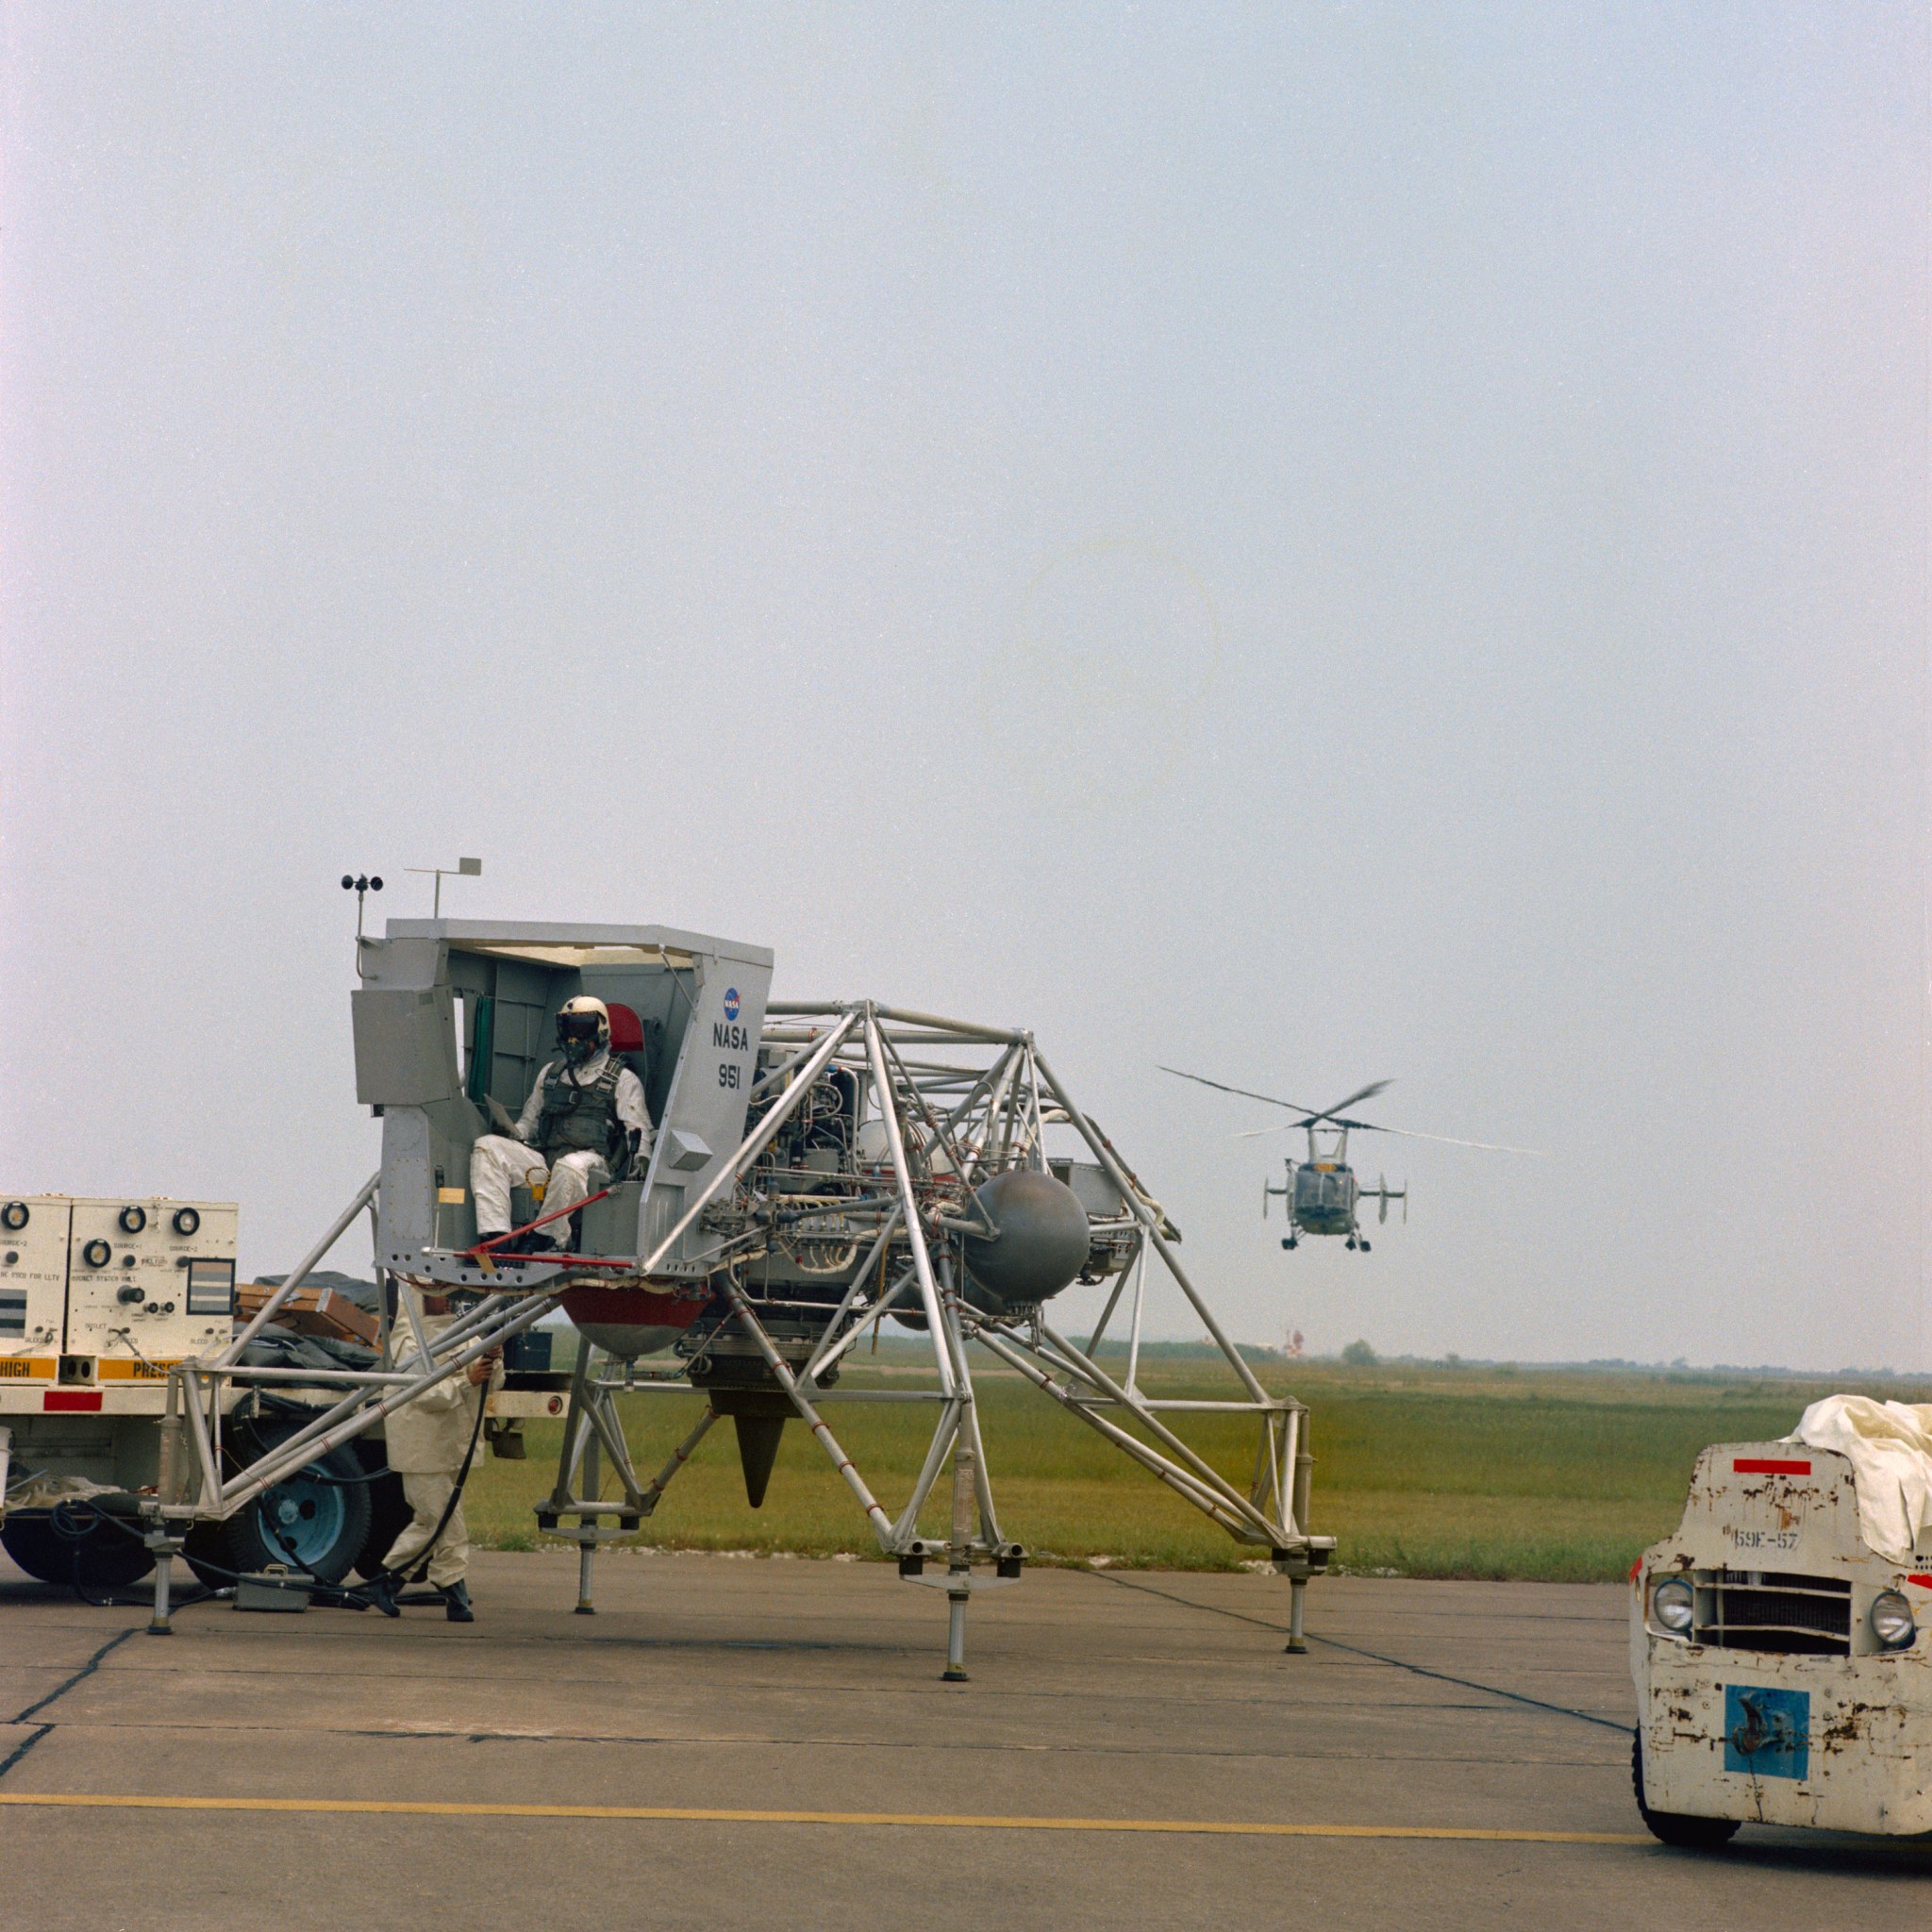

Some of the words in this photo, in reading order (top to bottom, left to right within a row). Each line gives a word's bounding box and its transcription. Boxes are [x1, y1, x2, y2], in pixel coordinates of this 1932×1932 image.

[724, 999, 740, 1009] NASA
[713, 1023, 748, 1051] NASA
[719, 1063, 741, 1090] 951
[0, 1361, 30, 1377] HIGH
